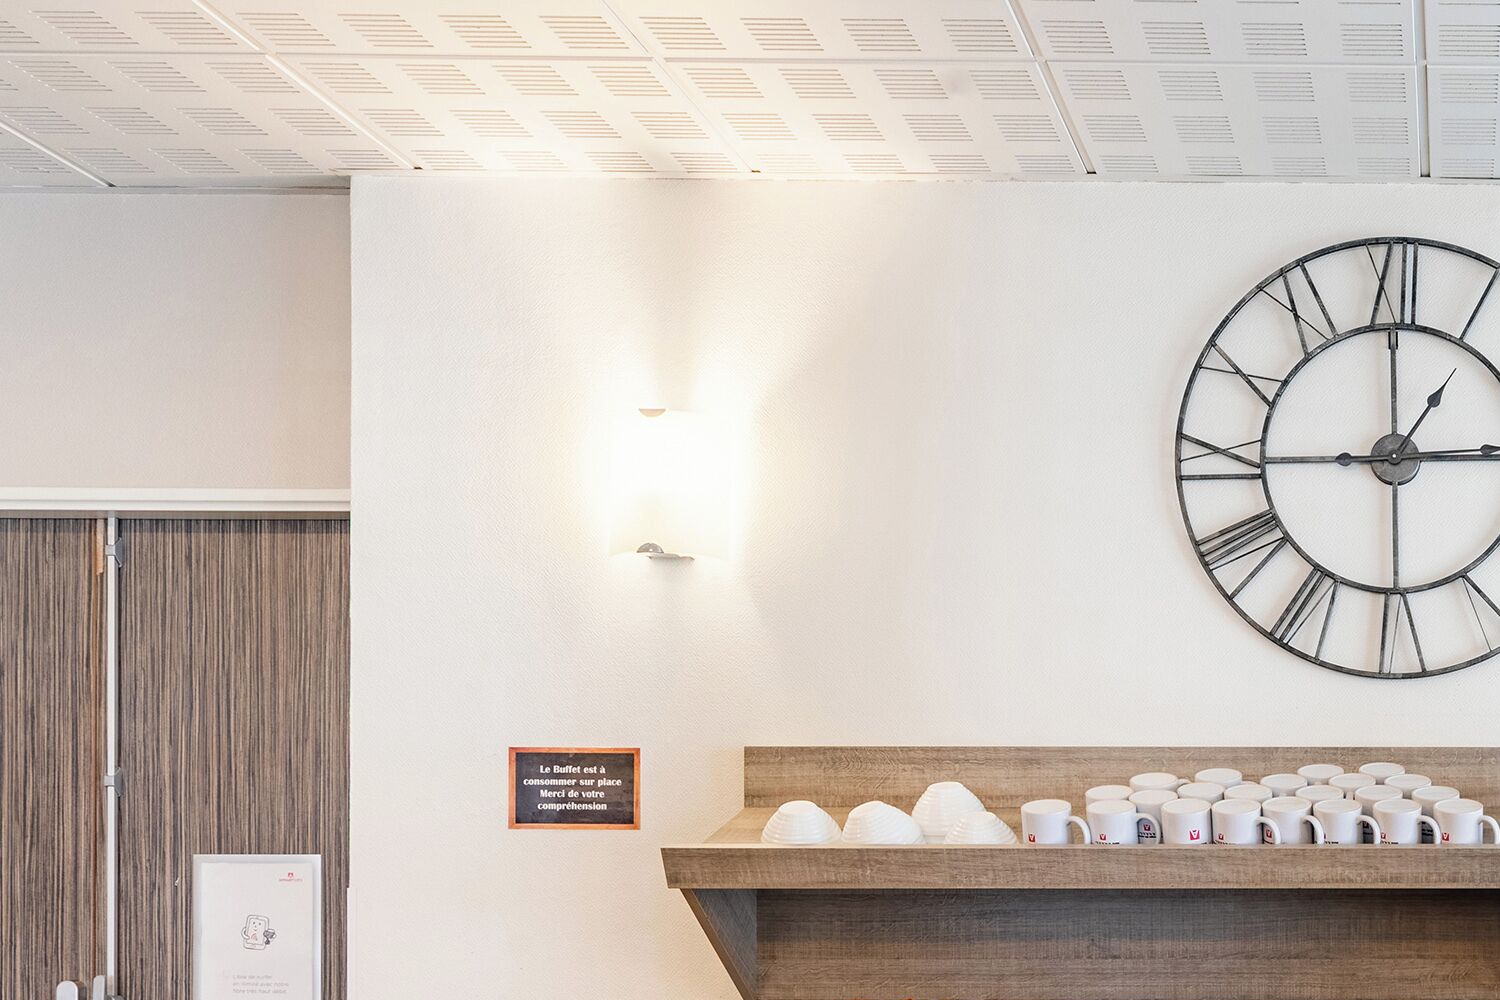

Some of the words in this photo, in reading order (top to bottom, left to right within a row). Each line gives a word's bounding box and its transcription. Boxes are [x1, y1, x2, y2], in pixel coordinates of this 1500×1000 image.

[540, 765, 551, 774] Le
[553, 765, 581, 774] Buffet
[583, 765, 597, 774] est
[599, 765, 606, 774] à
[523, 778, 577, 786] consommer
[597, 778, 622, 788] place
[540, 789, 565, 798] Merci
[568, 789, 579, 798] de
[581, 790, 605, 798] votre
[537, 801, 607, 812] compréhension
